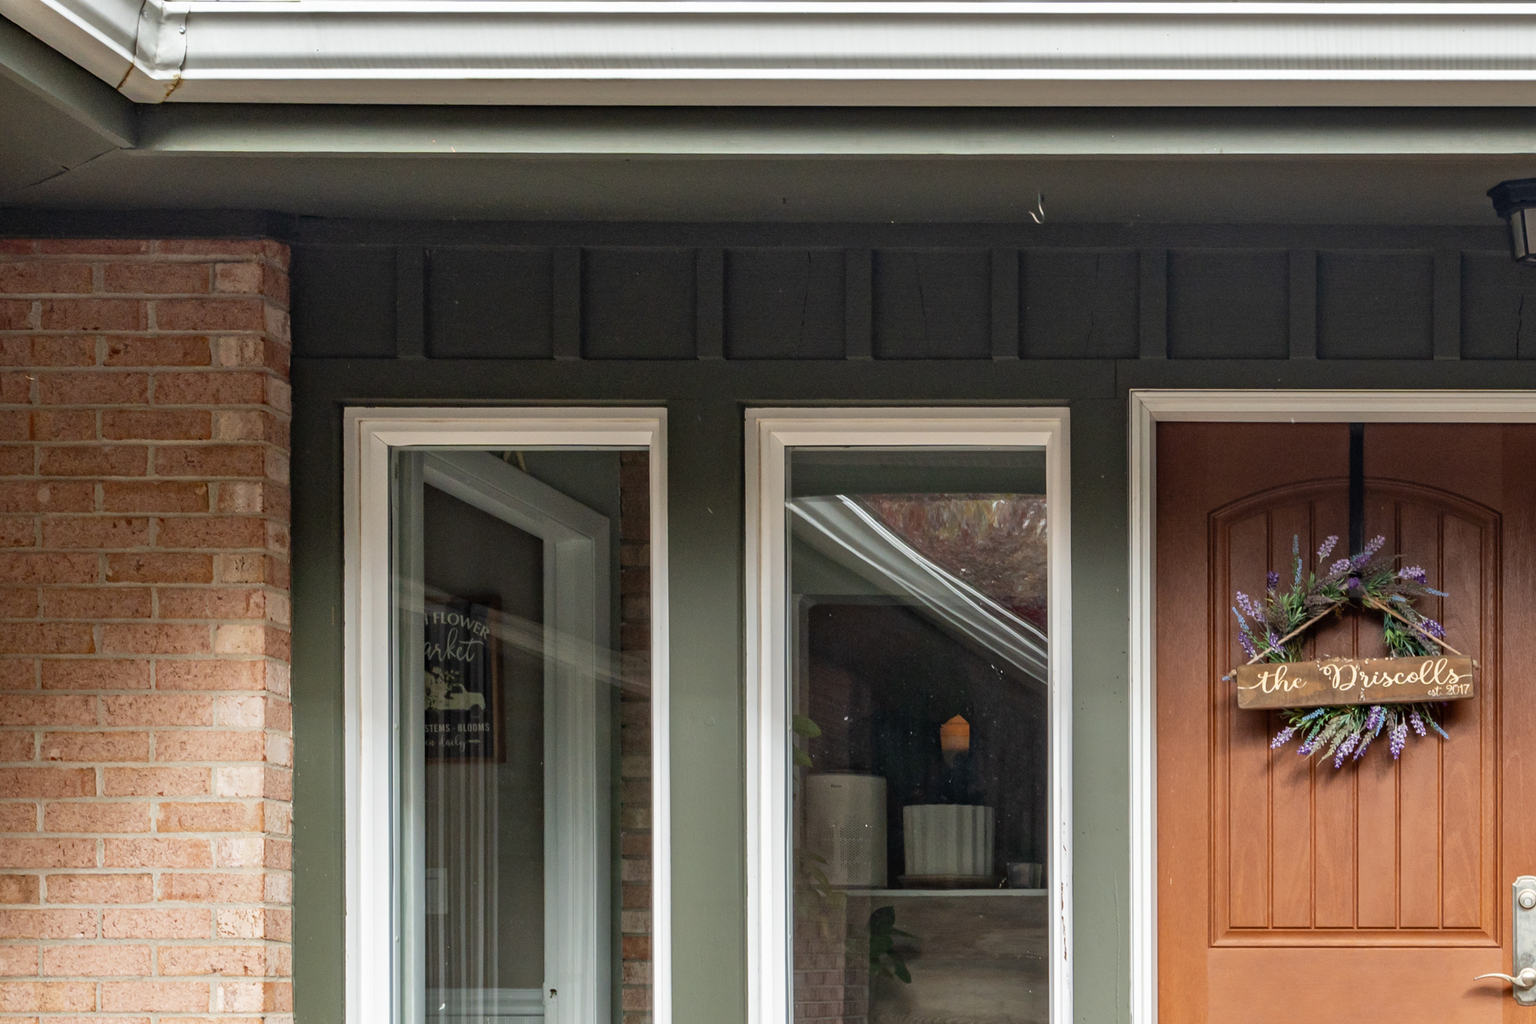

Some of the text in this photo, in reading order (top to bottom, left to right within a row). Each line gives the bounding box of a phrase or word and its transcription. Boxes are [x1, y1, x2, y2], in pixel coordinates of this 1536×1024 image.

[433, 612, 490, 640] FLOWER
[425, 627, 484, 662] arket
[1238, 658, 1472, 694] the Driscolls
[1445, 684, 1470, 696] 2017
[425, 722, 490, 733] STEMS BLOOMS
